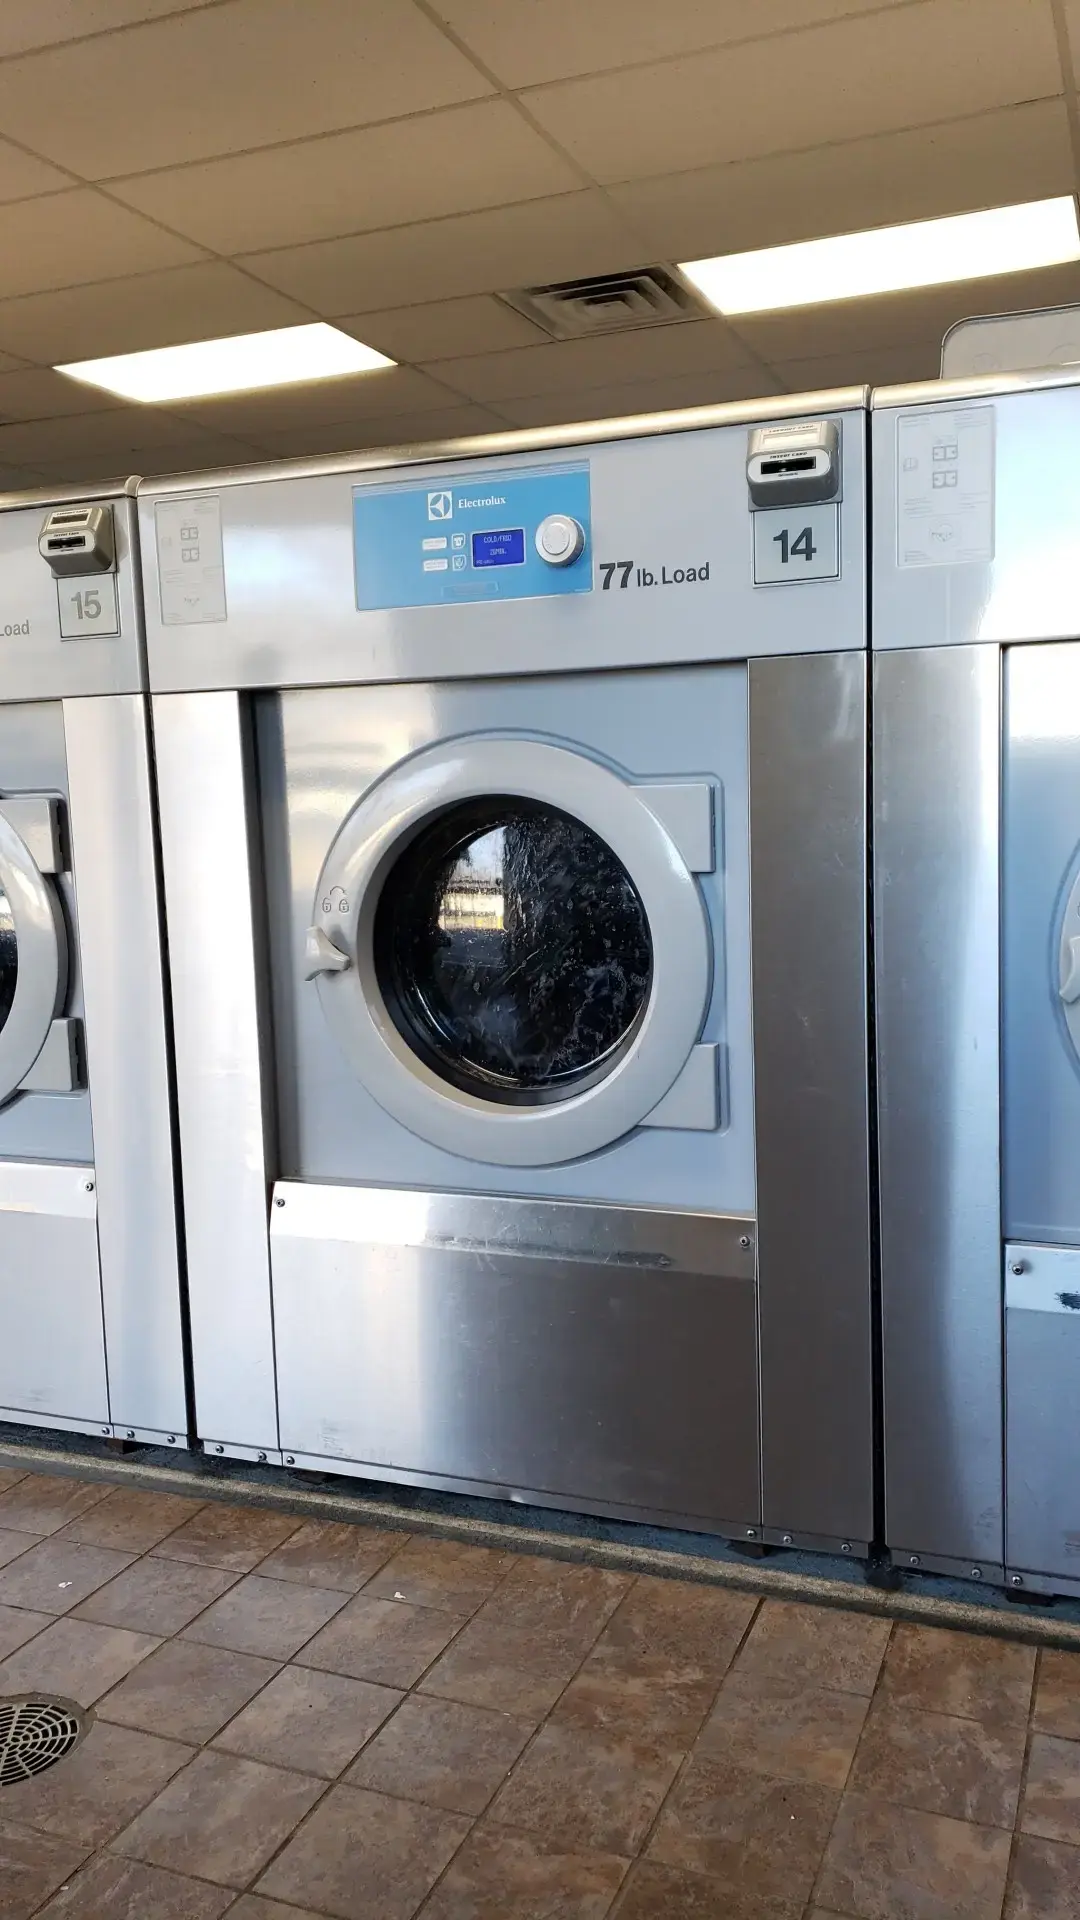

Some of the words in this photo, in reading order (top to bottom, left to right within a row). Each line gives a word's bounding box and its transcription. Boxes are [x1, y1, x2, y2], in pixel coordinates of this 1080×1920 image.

[458, 495, 507, 509] Electrolux
[772, 526, 817, 563] 14
[599, 560, 634, 590] 77
[637, 568, 658, 588] lb.
[662, 561, 710, 585] Load
[71, 589, 102, 620] 15
